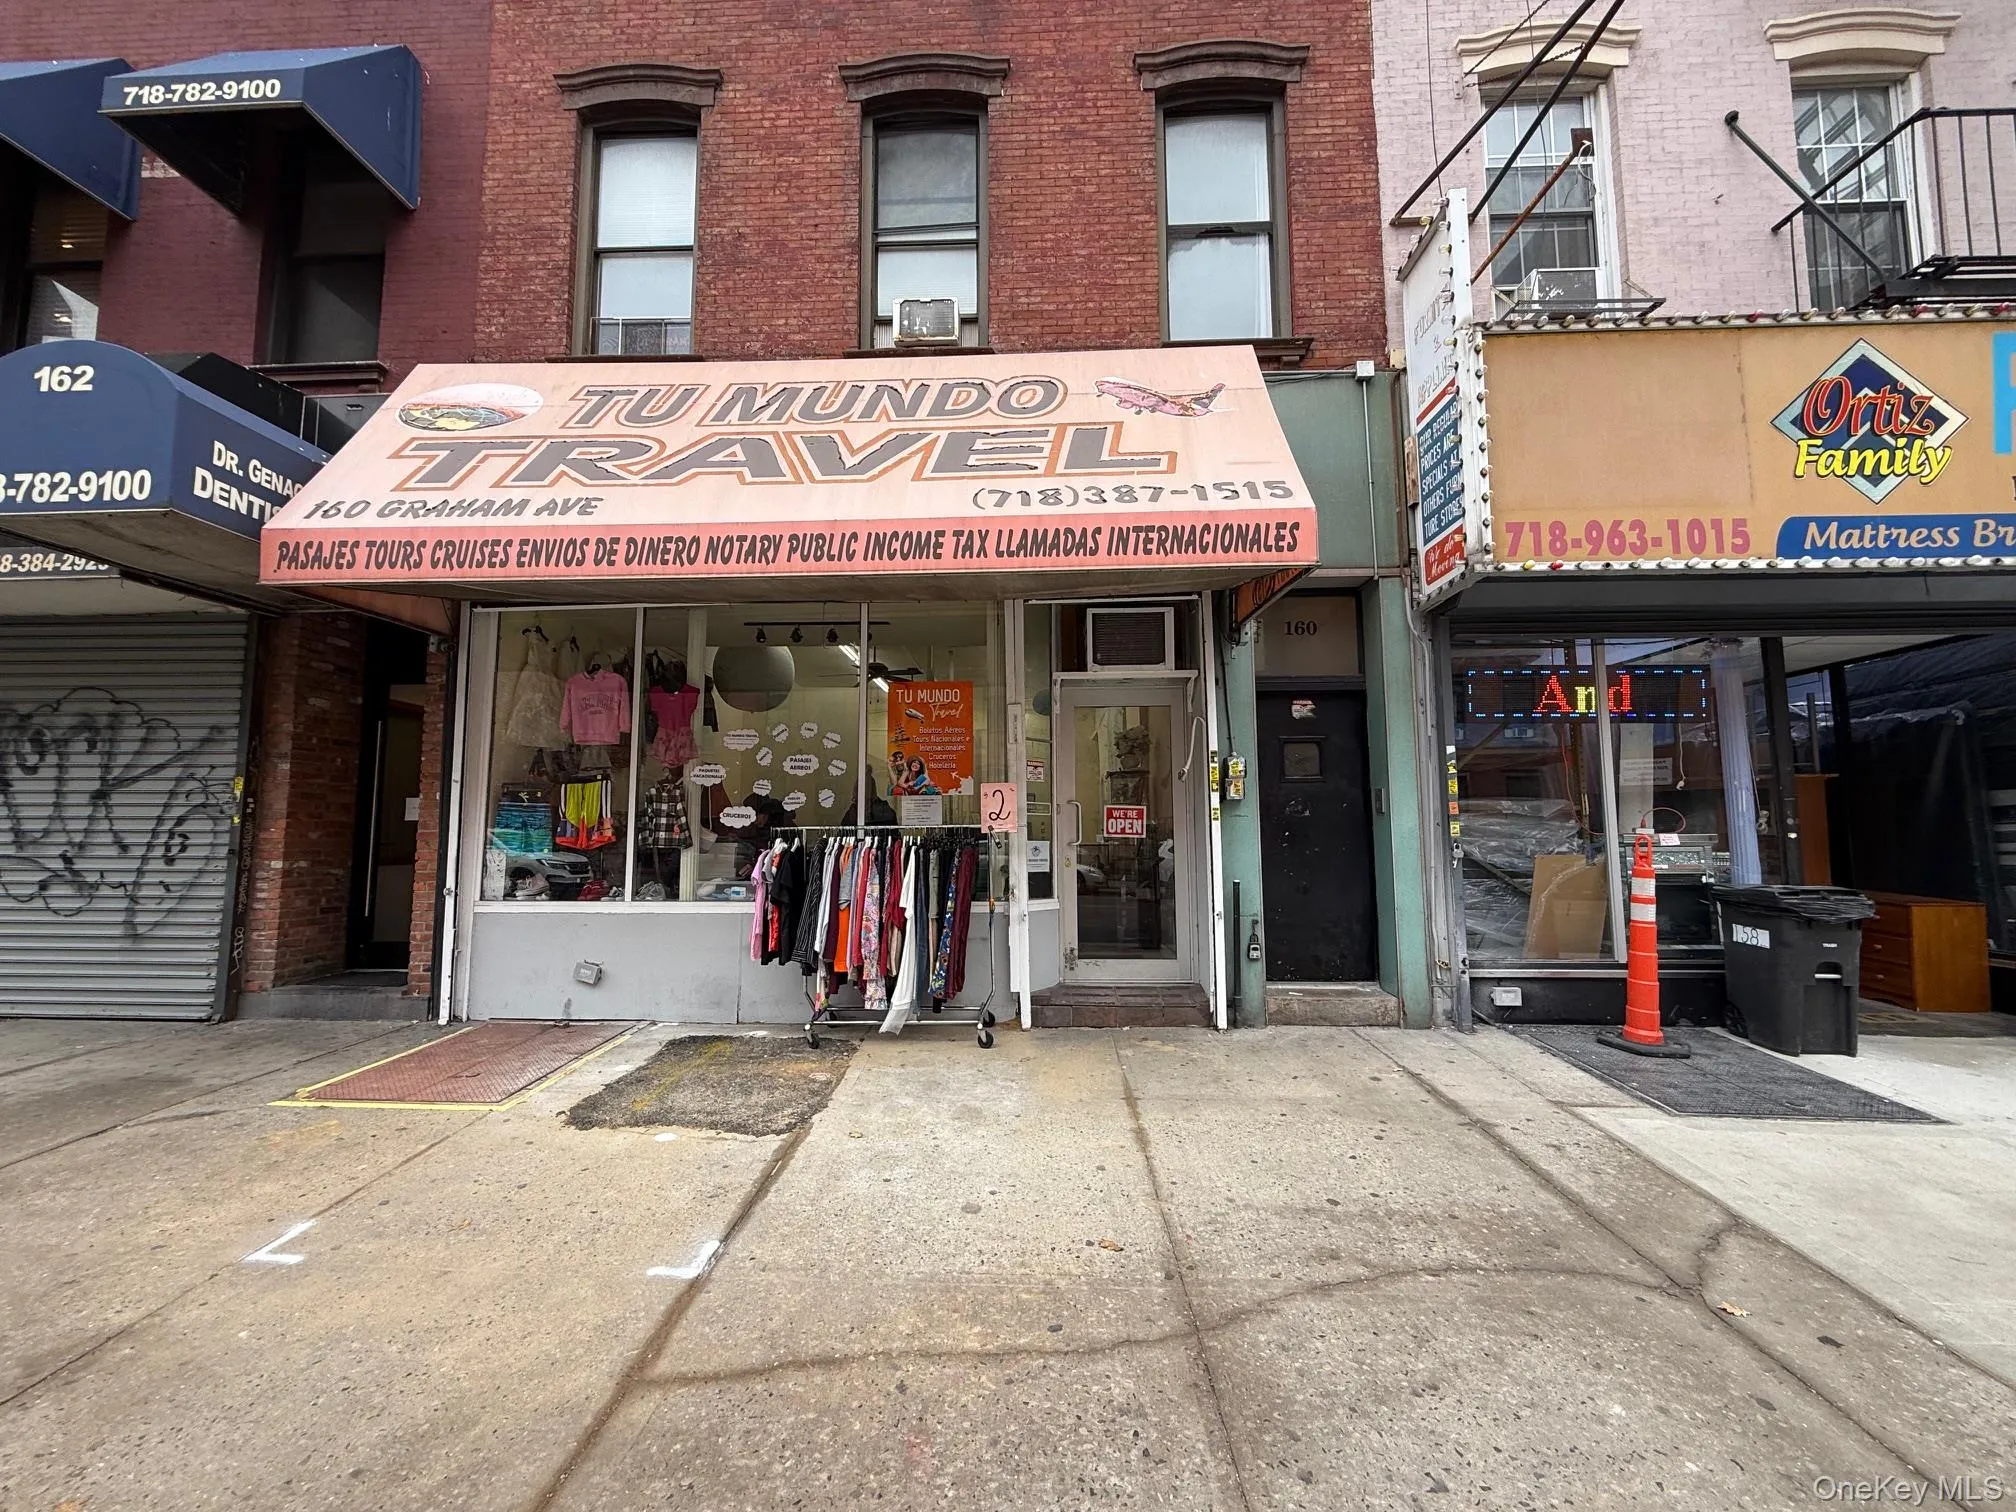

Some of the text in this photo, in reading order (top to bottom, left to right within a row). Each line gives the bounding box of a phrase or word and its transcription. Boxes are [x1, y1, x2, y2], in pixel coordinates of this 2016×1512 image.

[123, 79, 281, 105] 718-782-9100
[33, 365, 94, 393] 162
[560, 375, 1067, 429] TU MUNDO
[1804, 375, 1935, 437] Ortiz
[213, 440, 244, 478] DR.
[388, 421, 1176, 492] TRAVEL
[1794, 437, 1953, 487] Family
[1422, 459, 1448, 496] SPECIALS
[302, 496, 605, 522] 160 GRAHAM AVE
[972, 480, 1295, 511] (718)387-1515
[277, 521, 1301, 575] PASAJES TOURS CRUISES ENVIOS DE DINERO NOTARY PUBLIC INCOME TAX LLAMADAS INTERNACIONALES
[1504, 517, 1751, 558] 718-963-1015
[1803, 521, 1960, 550] Mattress
[1284, 620, 1318, 636] 160
[896, 688, 960, 704] TU MUNDO
[1533, 674, 1633, 713] And
[929, 702, 964, 722] Travel
[912, 735, 930, 743] Tours
[1107, 818, 1142, 834] OPEN
[1112, 809, 1138, 819] WE'RE
